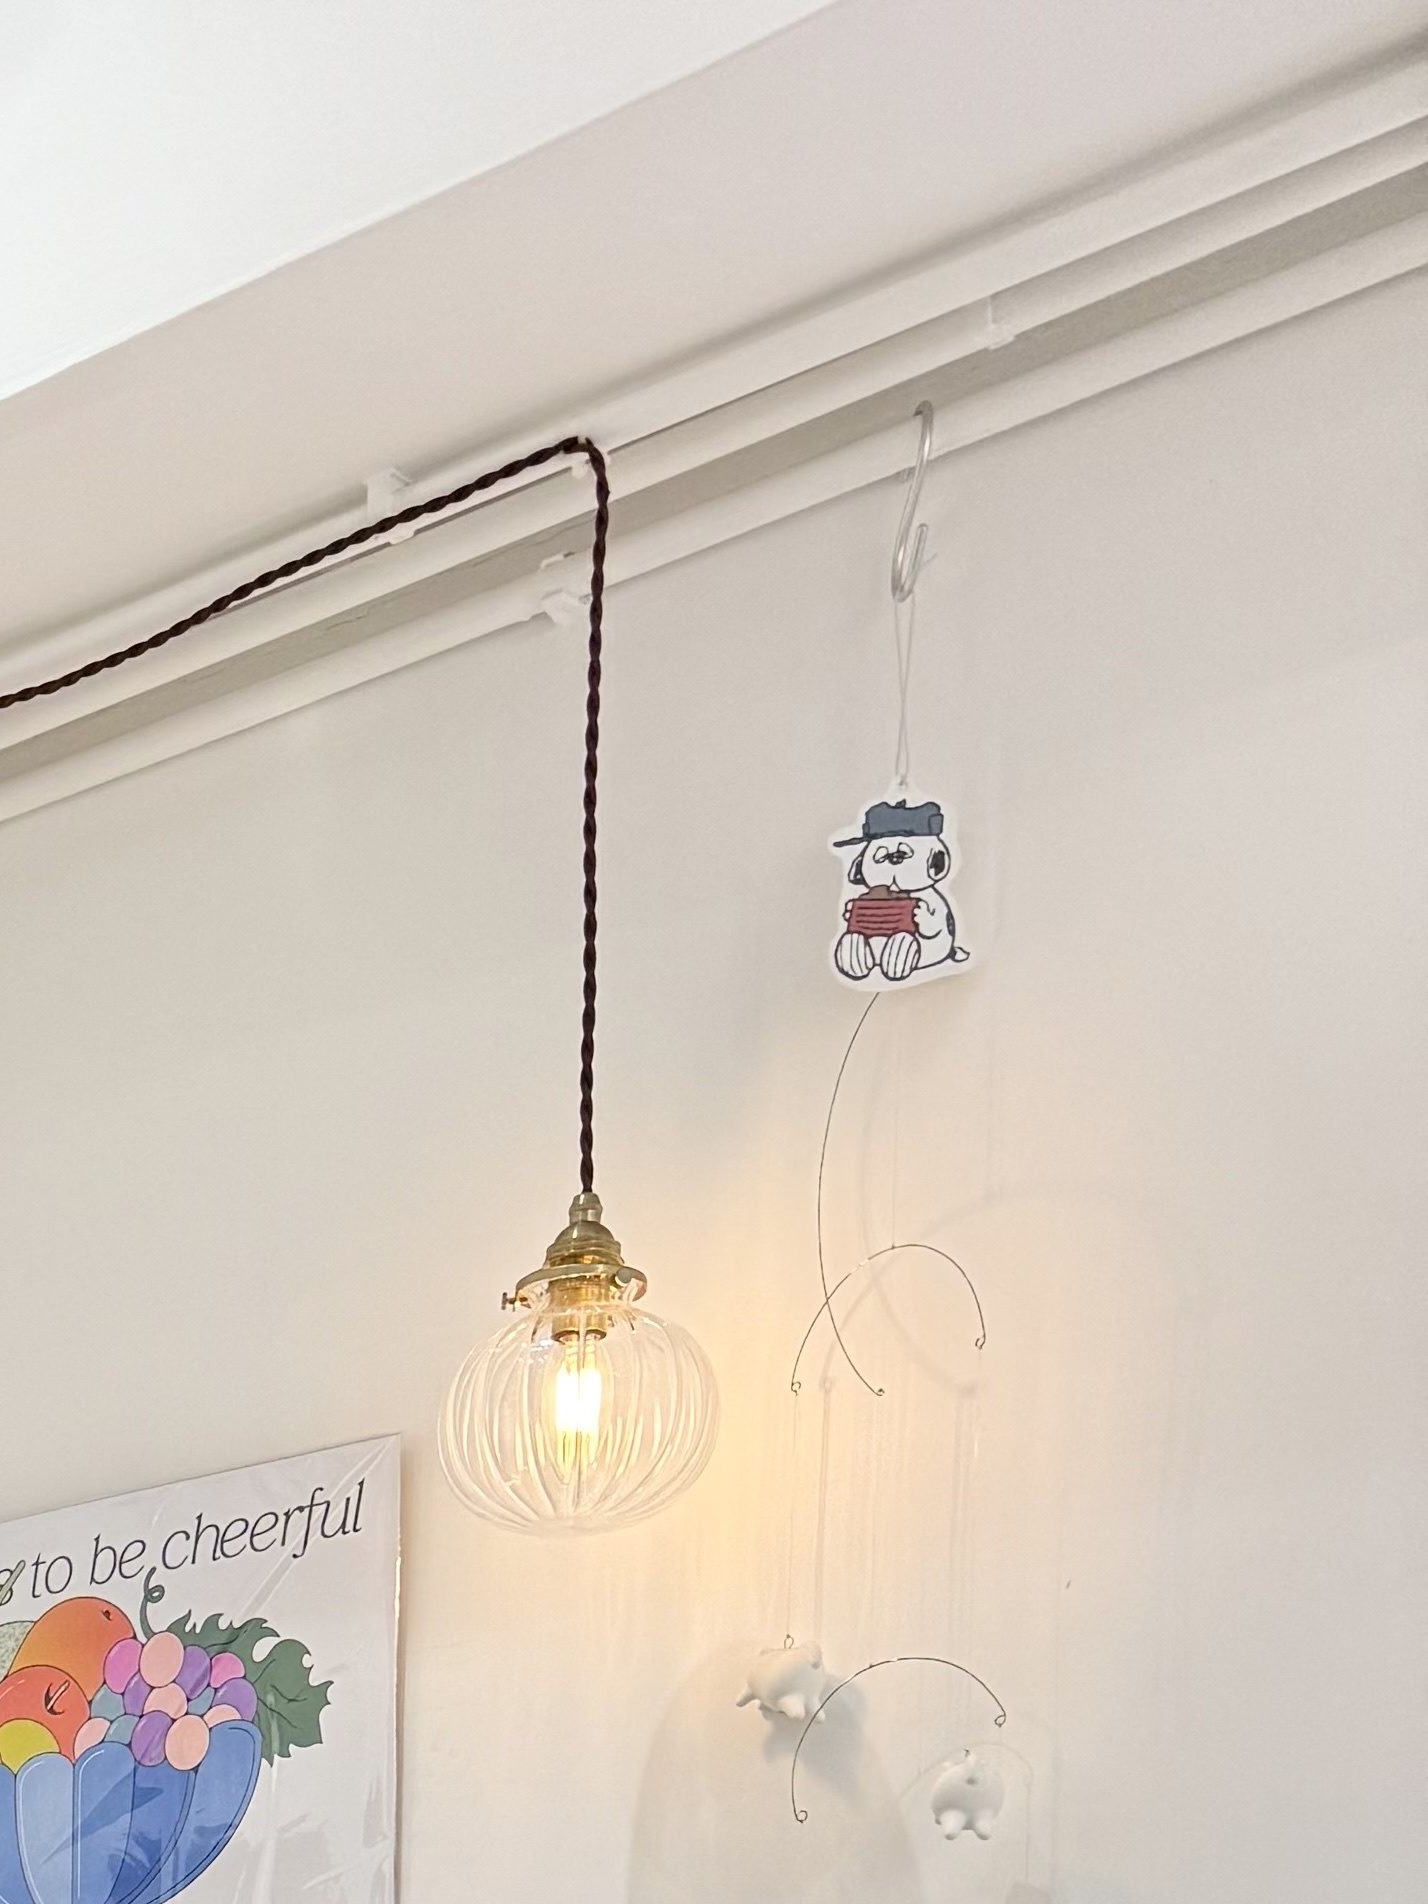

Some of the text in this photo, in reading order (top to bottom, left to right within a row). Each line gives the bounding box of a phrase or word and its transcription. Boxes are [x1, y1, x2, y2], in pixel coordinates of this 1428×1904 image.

[31, 1552, 73, 1599] to
[89, 1534, 146, 1586] be
[160, 1478, 366, 1570] cheerful
